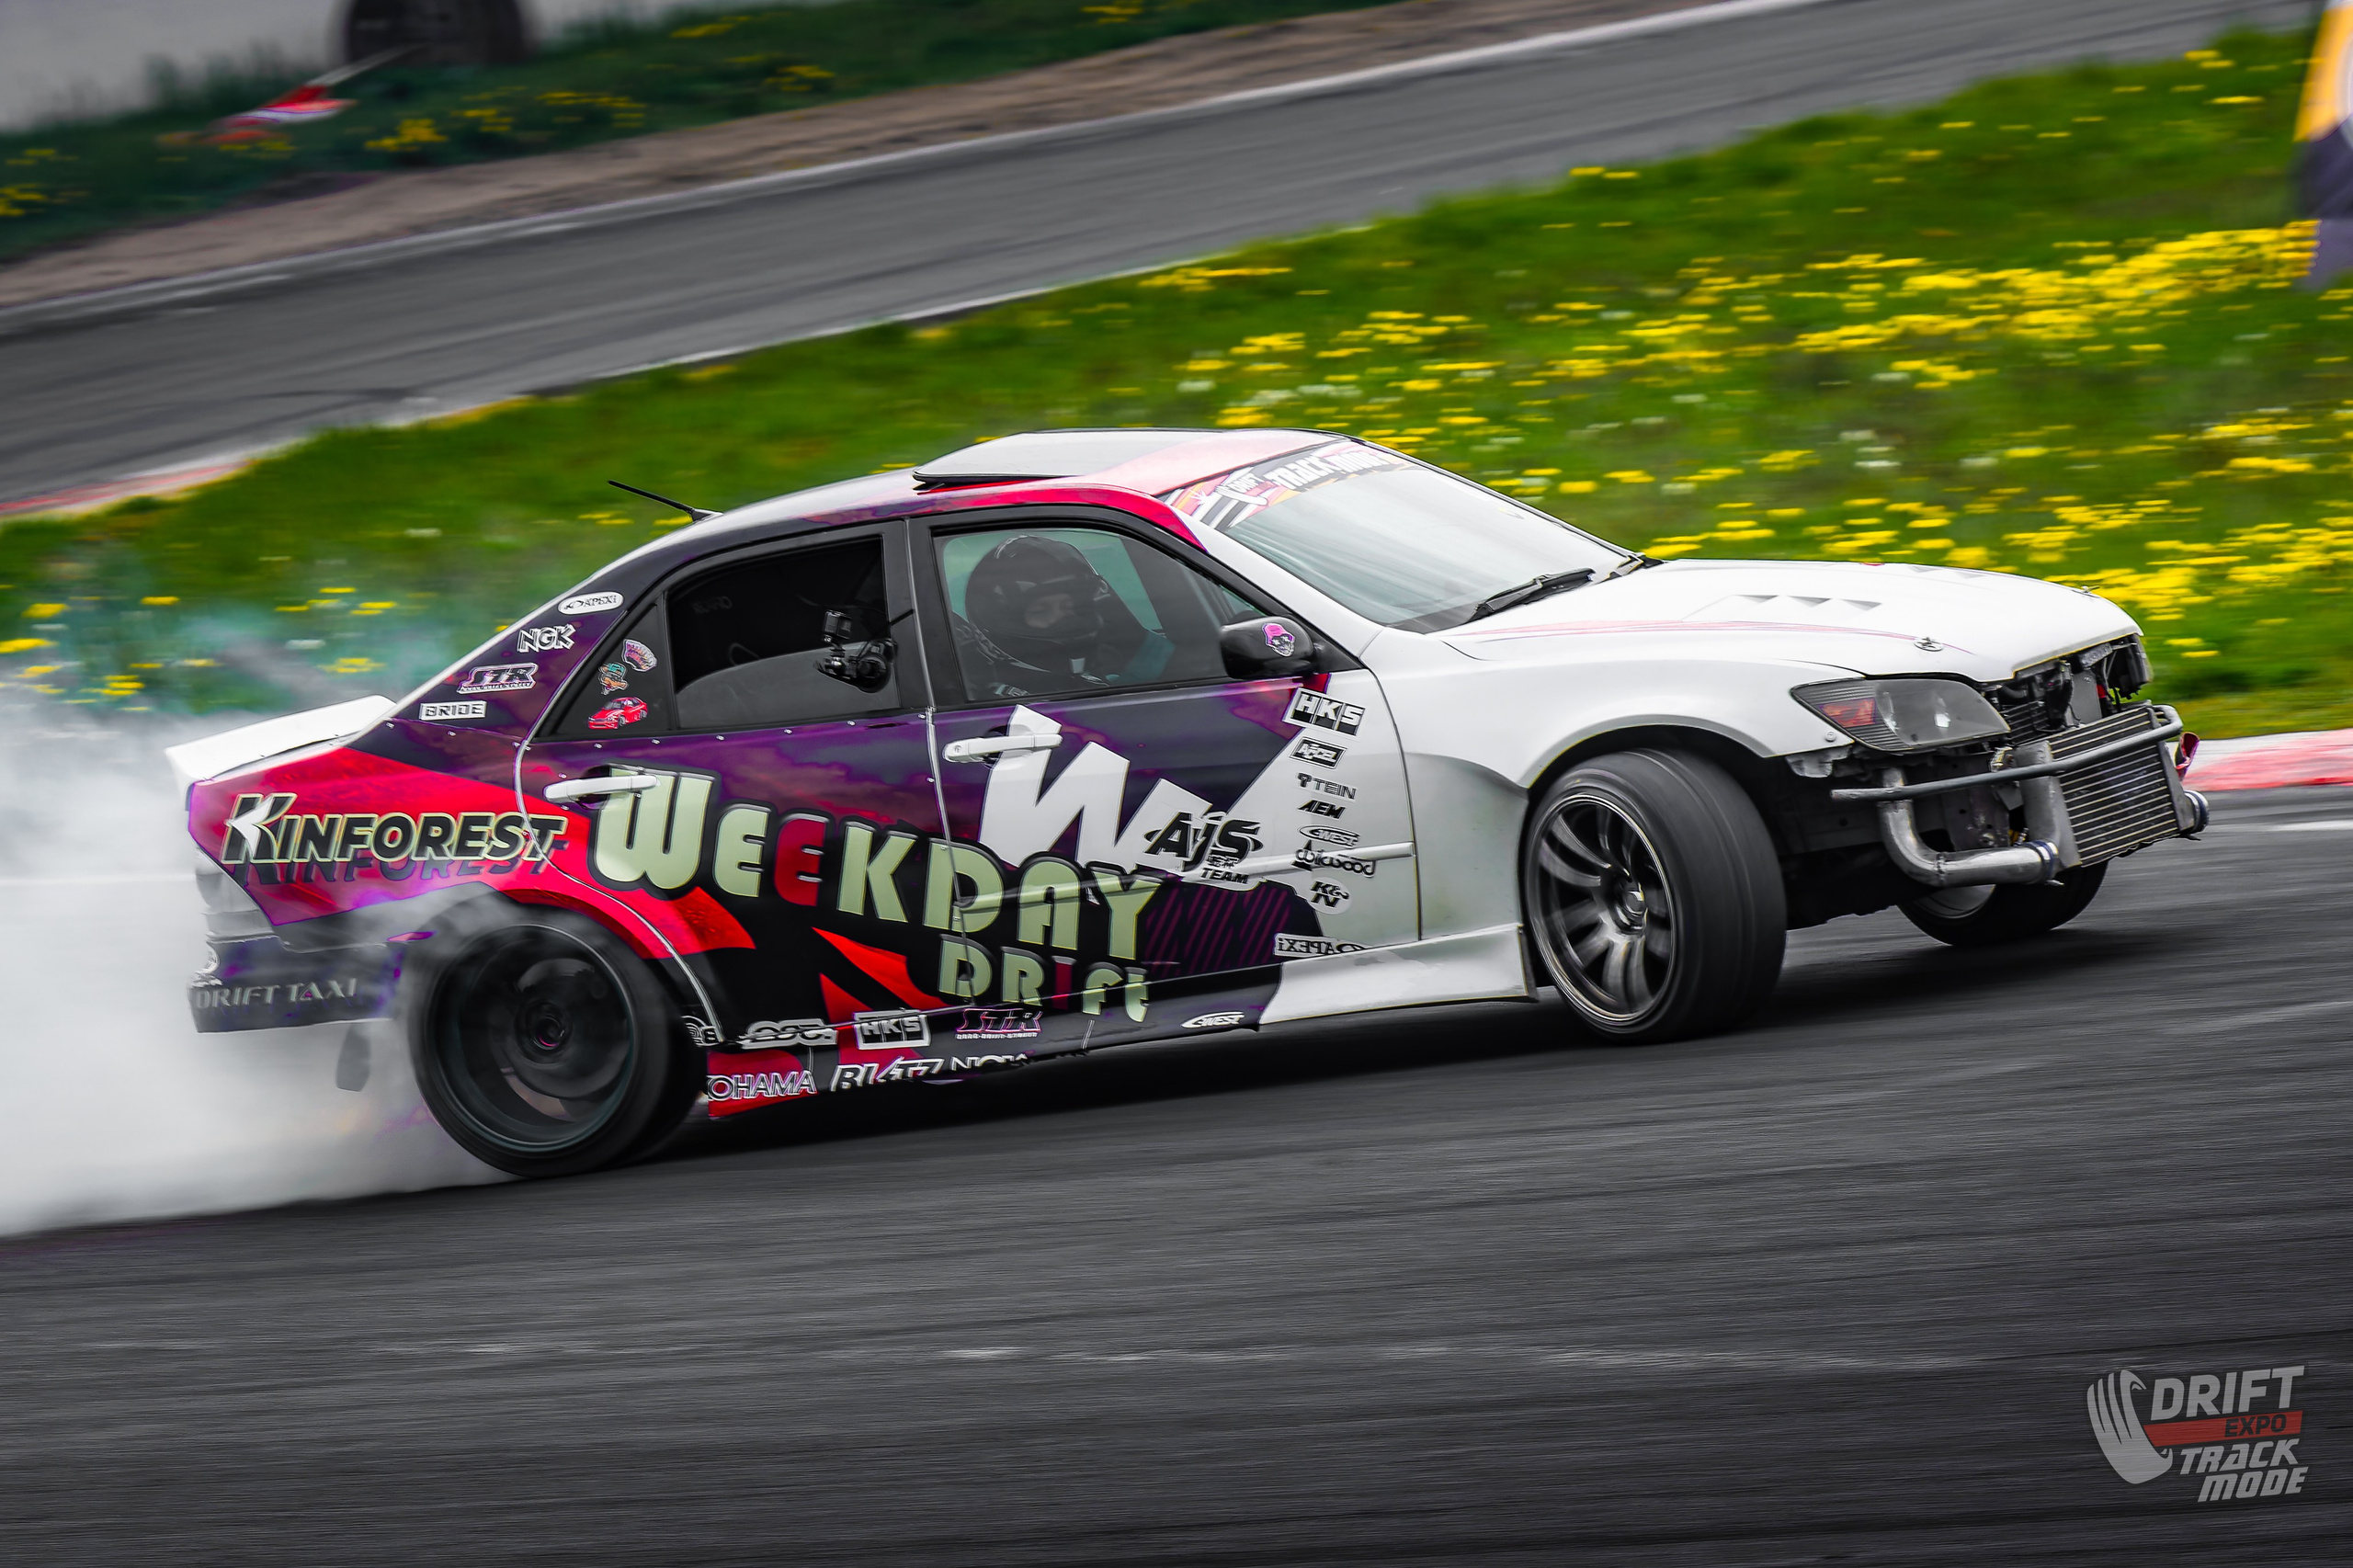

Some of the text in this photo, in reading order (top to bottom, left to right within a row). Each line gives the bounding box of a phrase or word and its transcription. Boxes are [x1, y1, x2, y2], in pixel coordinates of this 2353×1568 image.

[1263, 454, 1343, 490] TRACK
[517, 623, 576, 653] NGK
[421, 703, 484, 718] BRIDE
[1295, 693, 1364, 727] HKS
[1312, 777, 1357, 801] TEIN
[1298, 800, 1346, 820] AEM
[222, 791, 568, 865] KINFOREST
[592, 762, 1162, 961] WEEKDAY
[1200, 867, 1250, 884] TEAM
[196, 977, 358, 1009] DRIFT TAXI
[705, 1071, 817, 1101] OHAMA
